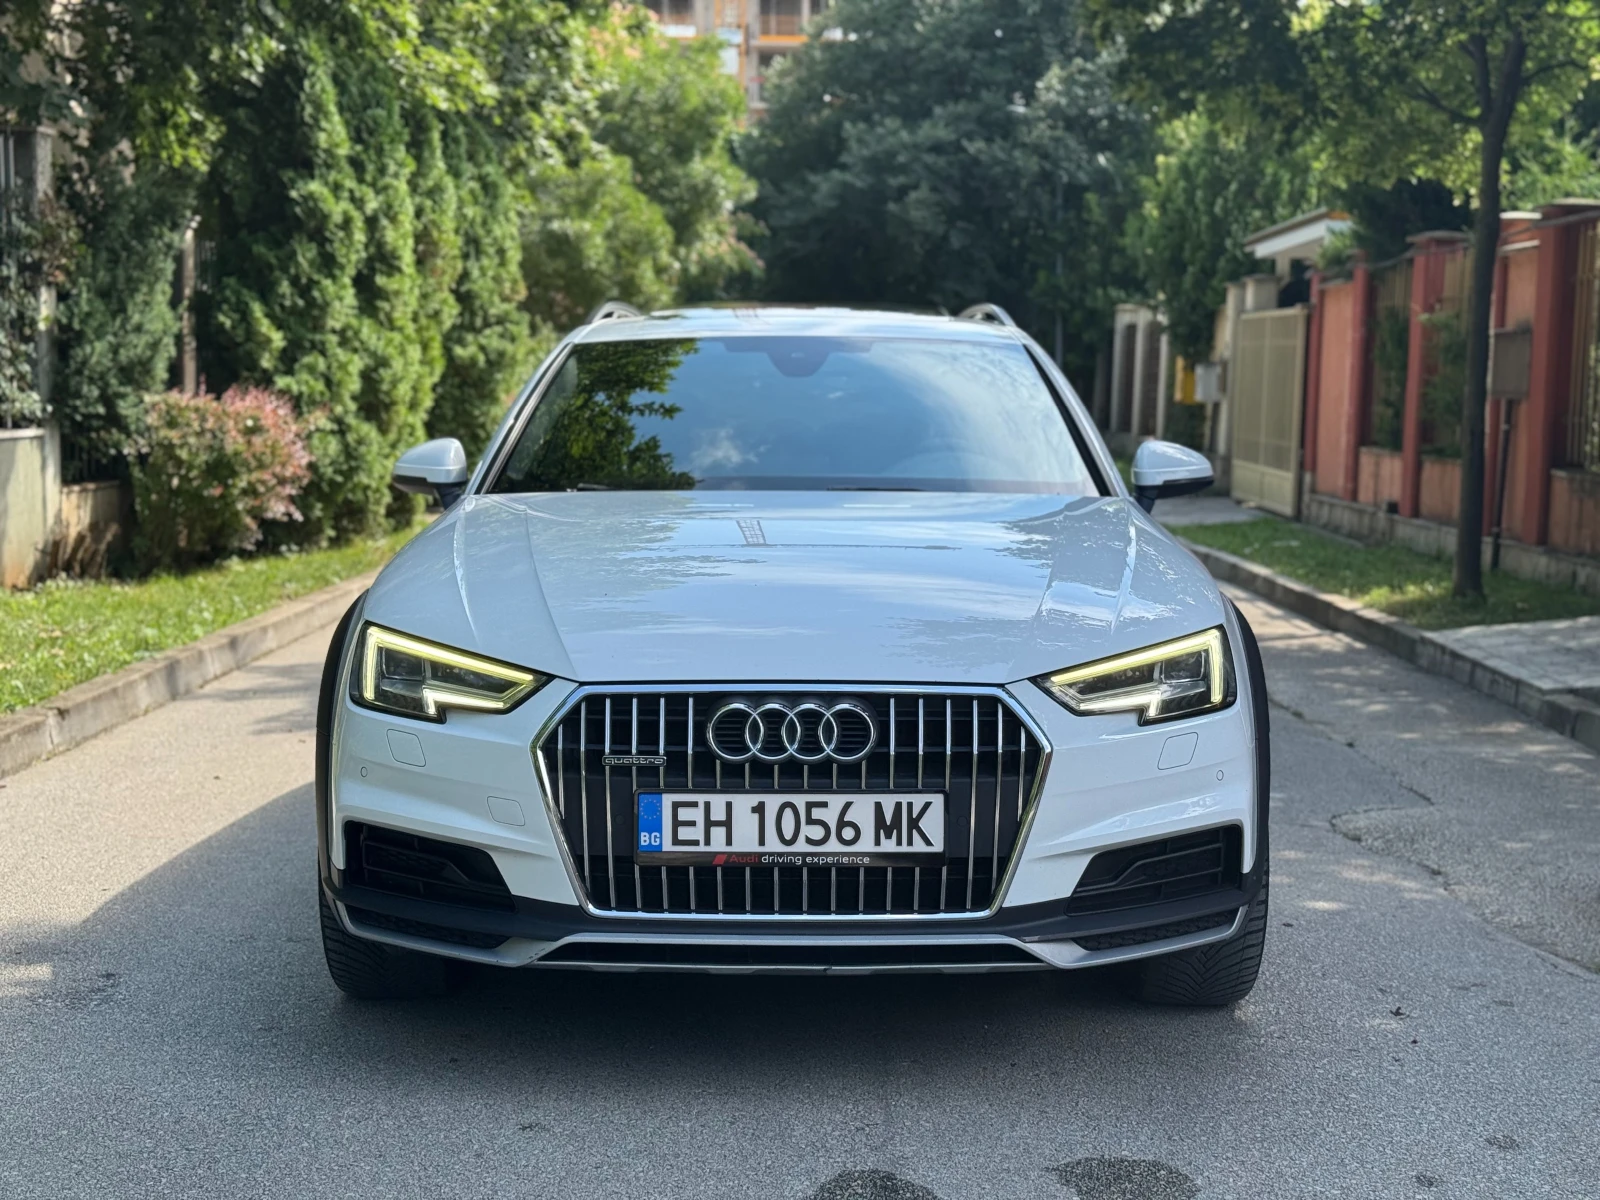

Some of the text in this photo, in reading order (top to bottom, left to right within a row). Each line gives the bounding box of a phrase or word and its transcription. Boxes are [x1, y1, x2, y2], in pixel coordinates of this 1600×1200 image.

[605, 757, 664, 765] quattro
[671, 800, 935, 847] EH 1056 MK
[640, 832, 661, 846] BG
[730, 853, 870, 866] Audi driving experience
